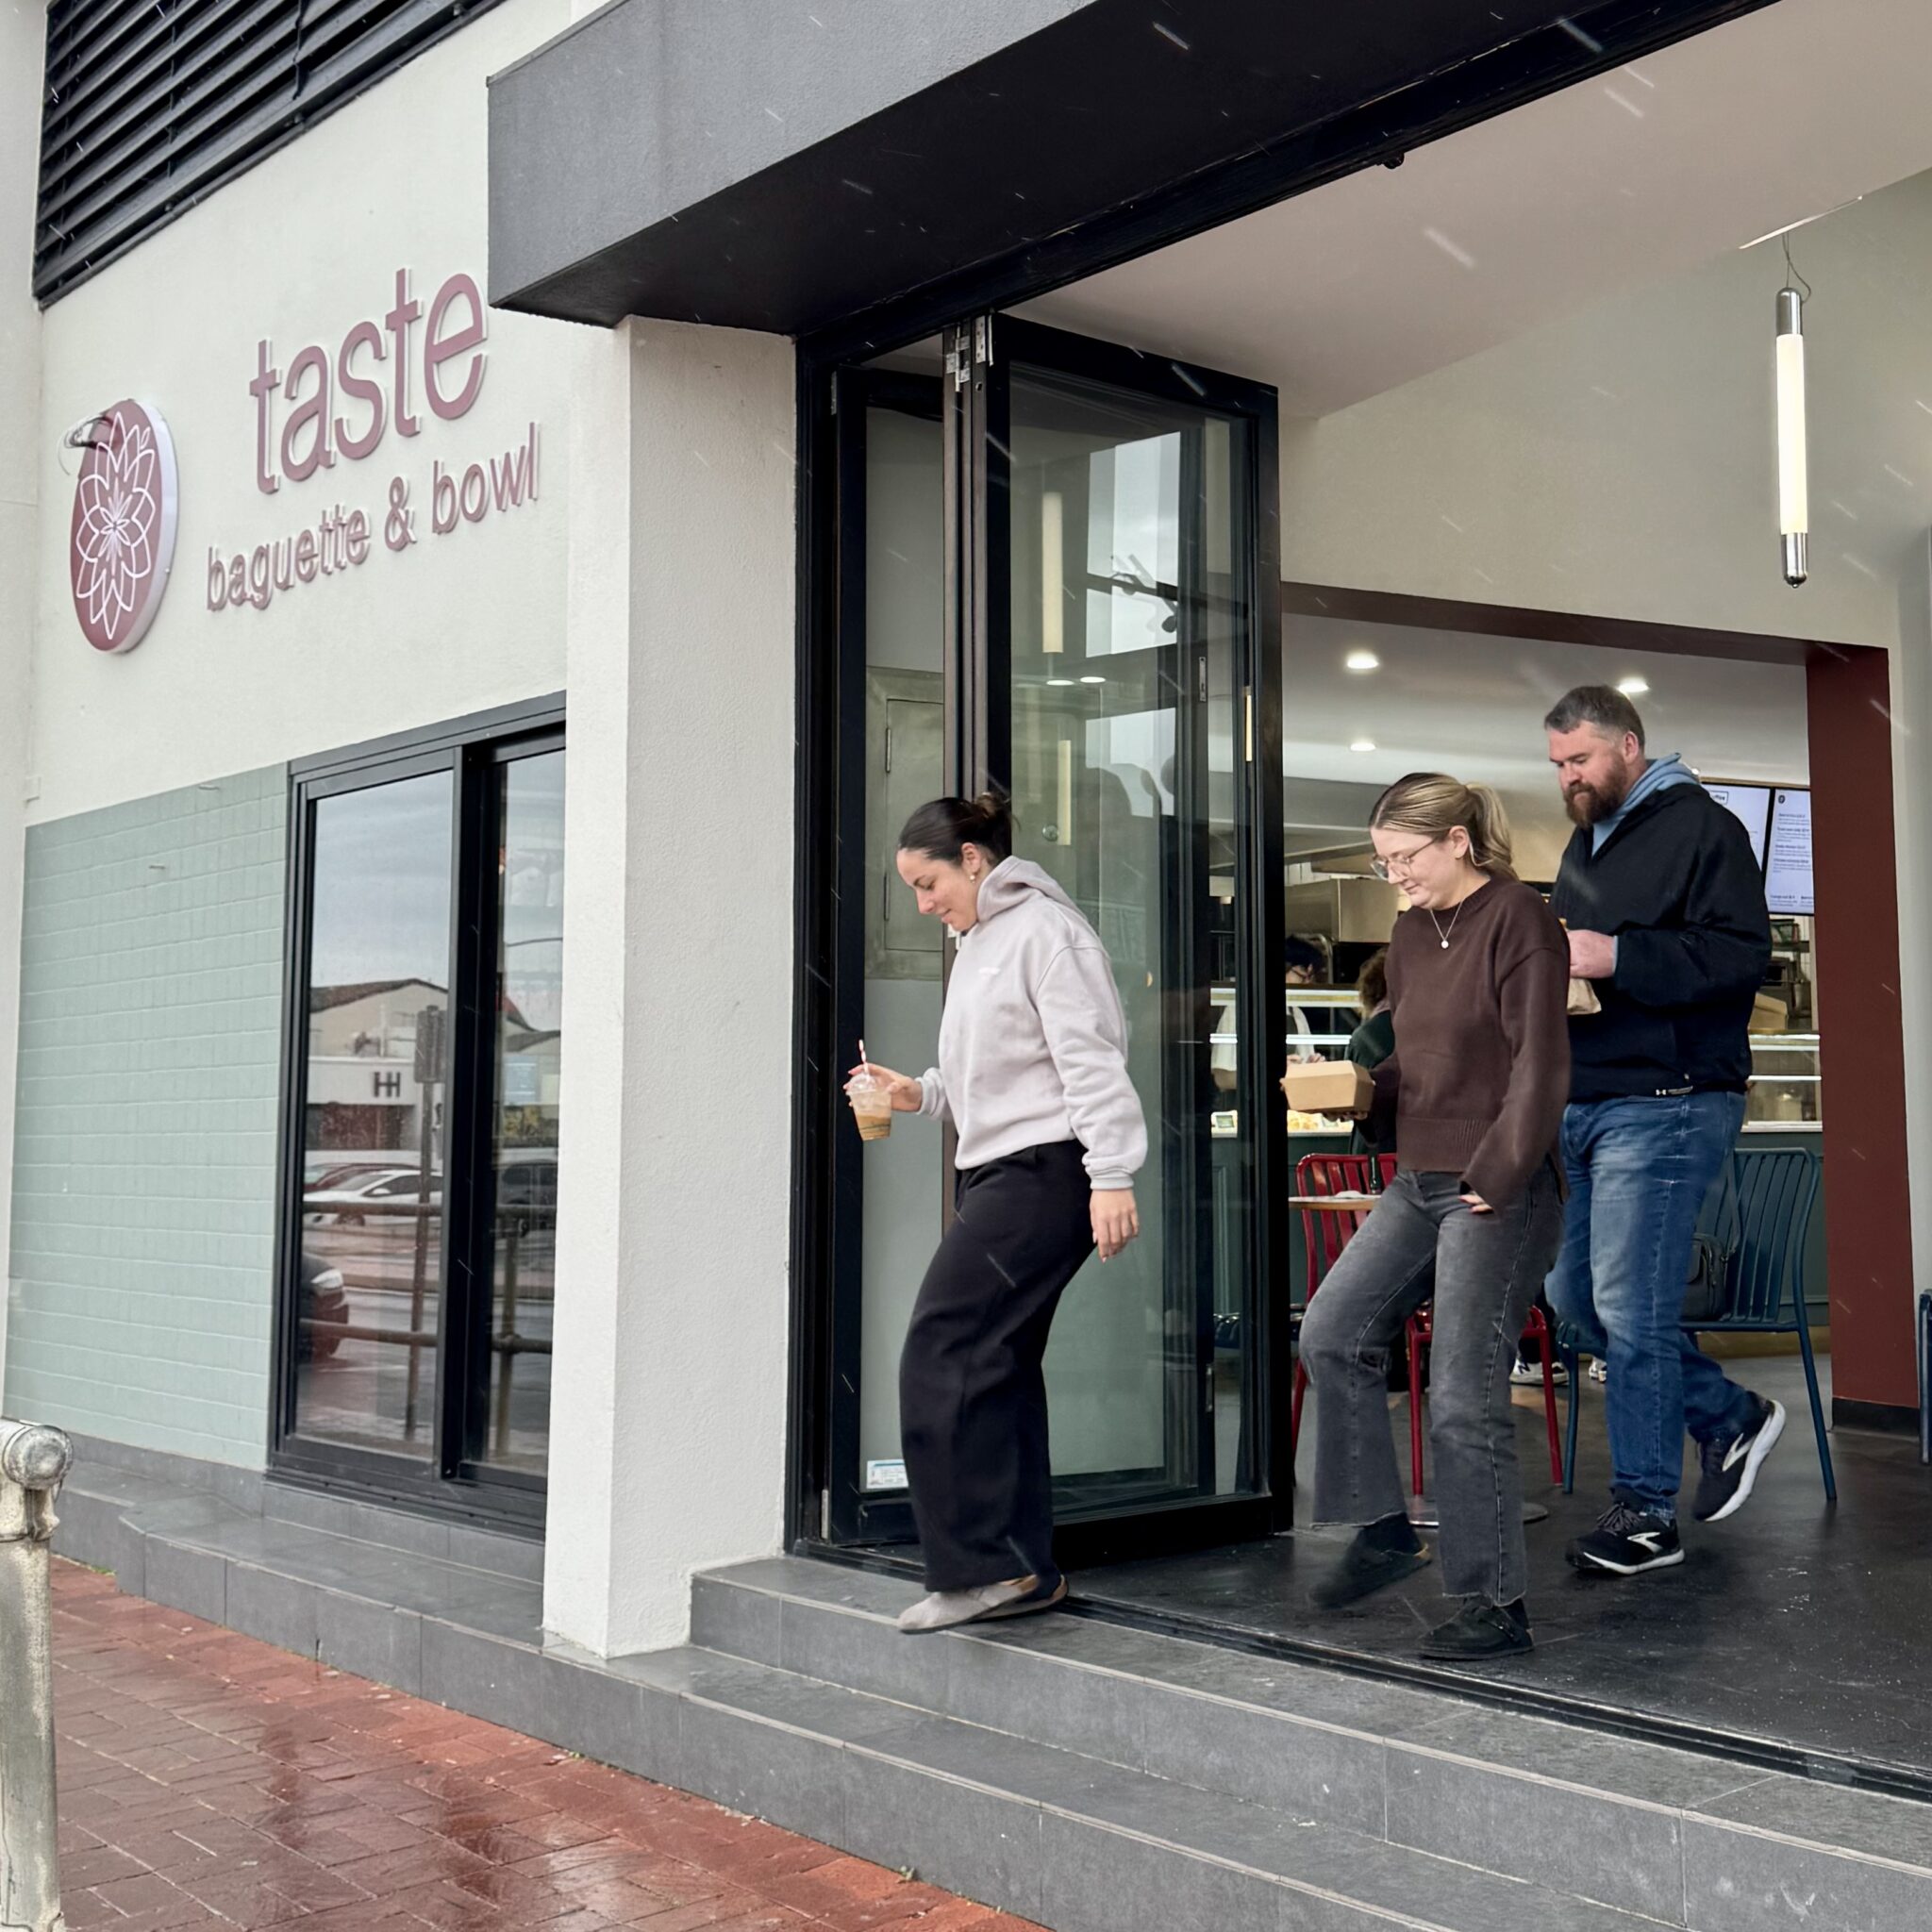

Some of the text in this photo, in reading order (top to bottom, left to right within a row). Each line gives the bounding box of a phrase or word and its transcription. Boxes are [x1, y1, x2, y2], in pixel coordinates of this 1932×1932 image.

[249, 268, 487, 494] taste
[207, 421, 539, 612] baguette & bowl
